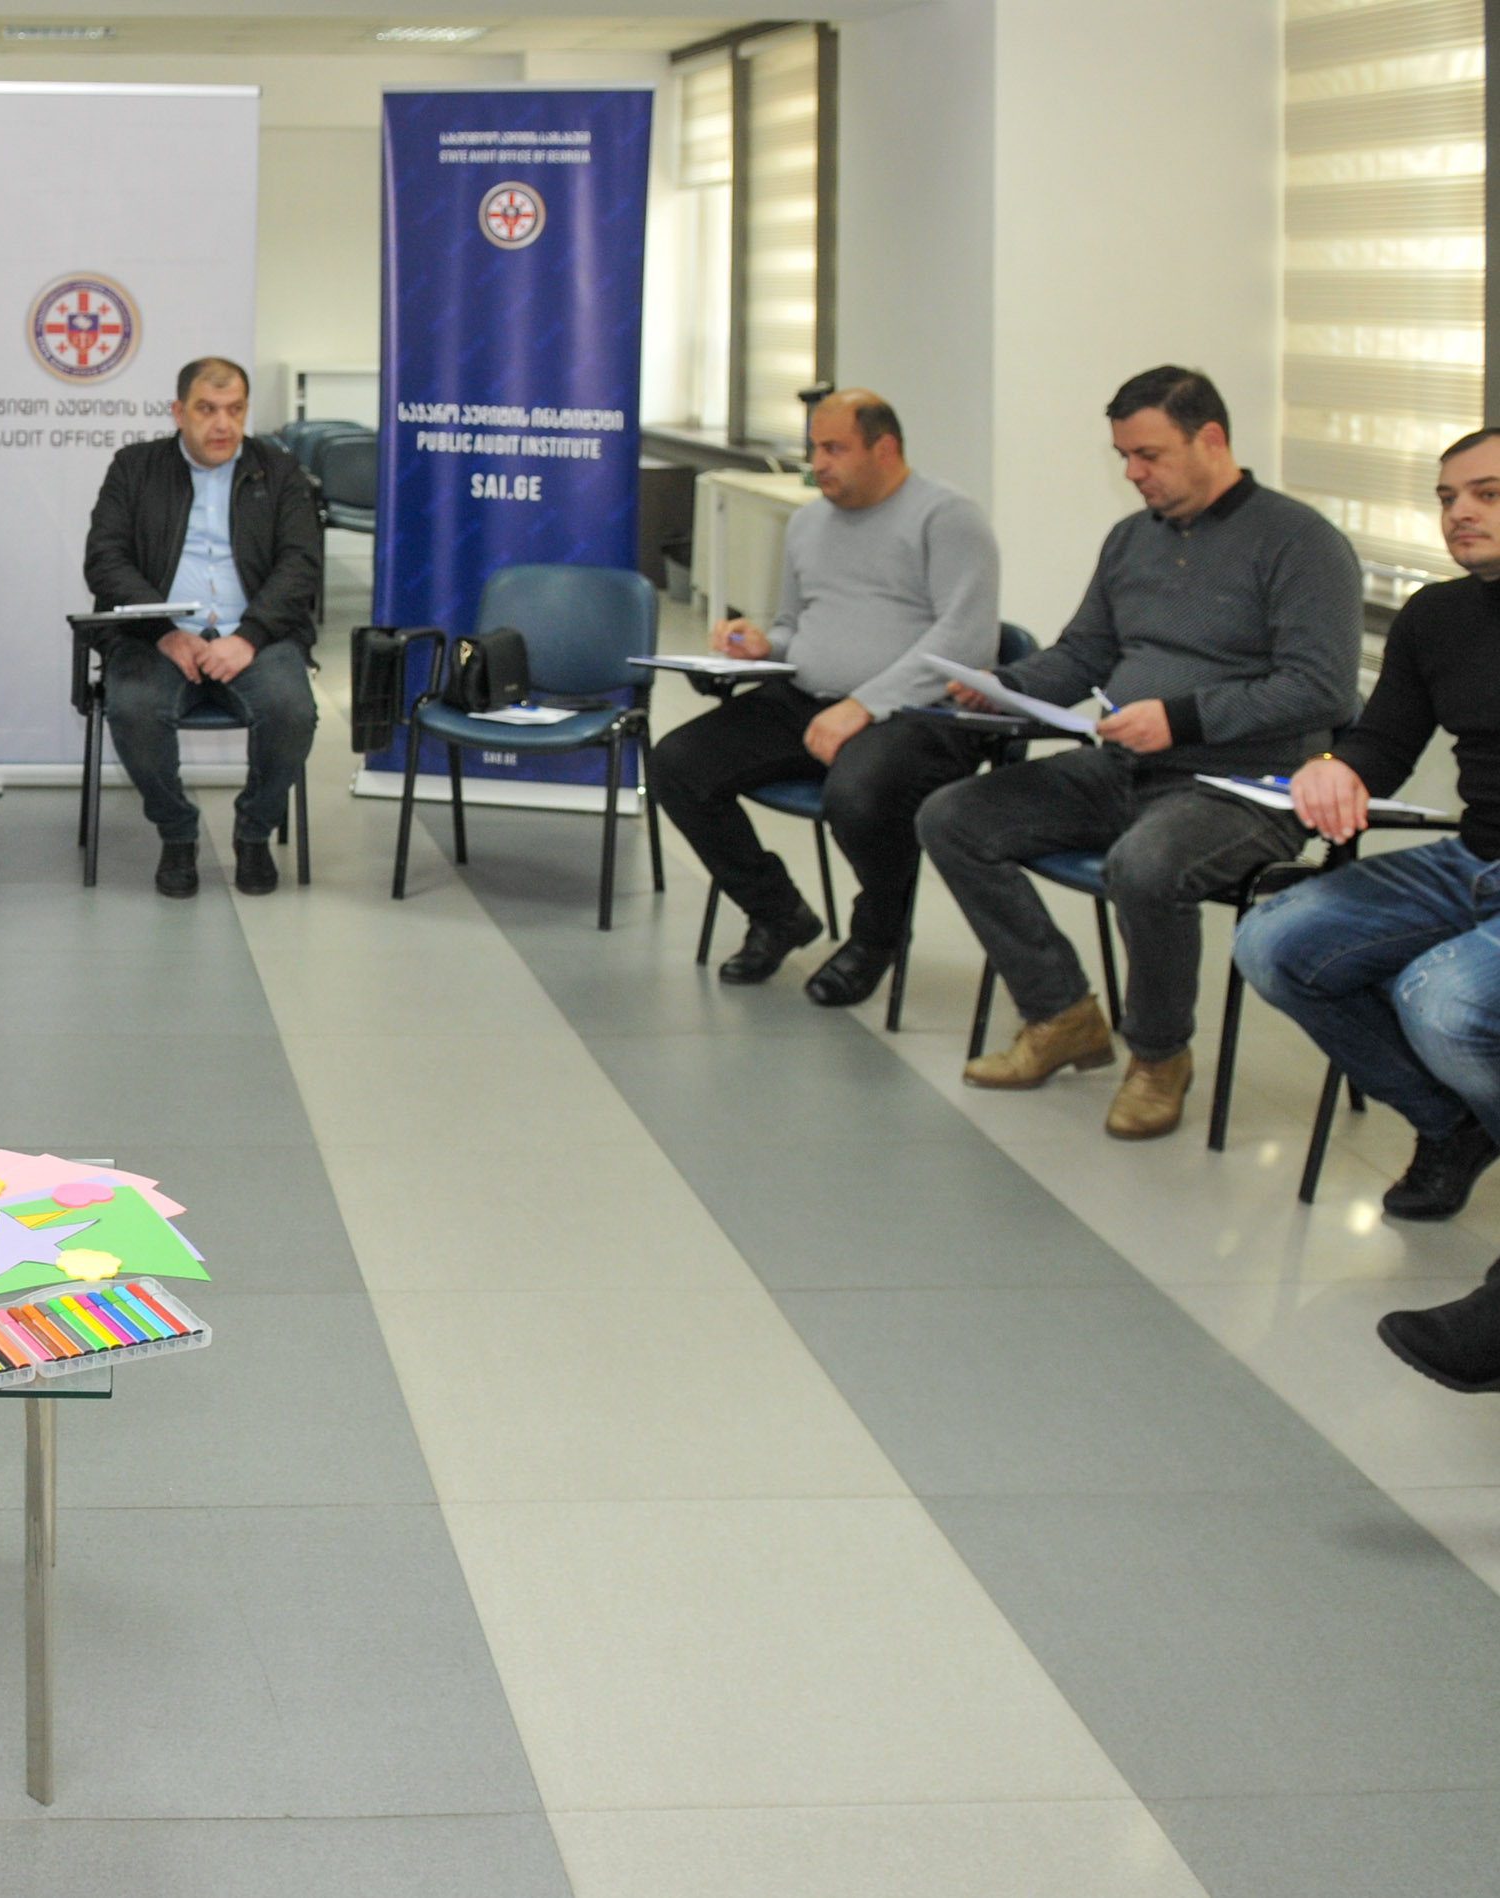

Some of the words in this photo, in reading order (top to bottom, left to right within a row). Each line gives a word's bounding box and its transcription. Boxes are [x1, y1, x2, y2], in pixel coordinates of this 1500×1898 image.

[50, 429, 115, 448] OFFICE
[416, 431, 473, 454] PUBLIC
[473, 433, 521, 456] AUDIT
[521, 435, 603, 460] INSTITUTE
[470, 473, 542, 501] SAI.GE
